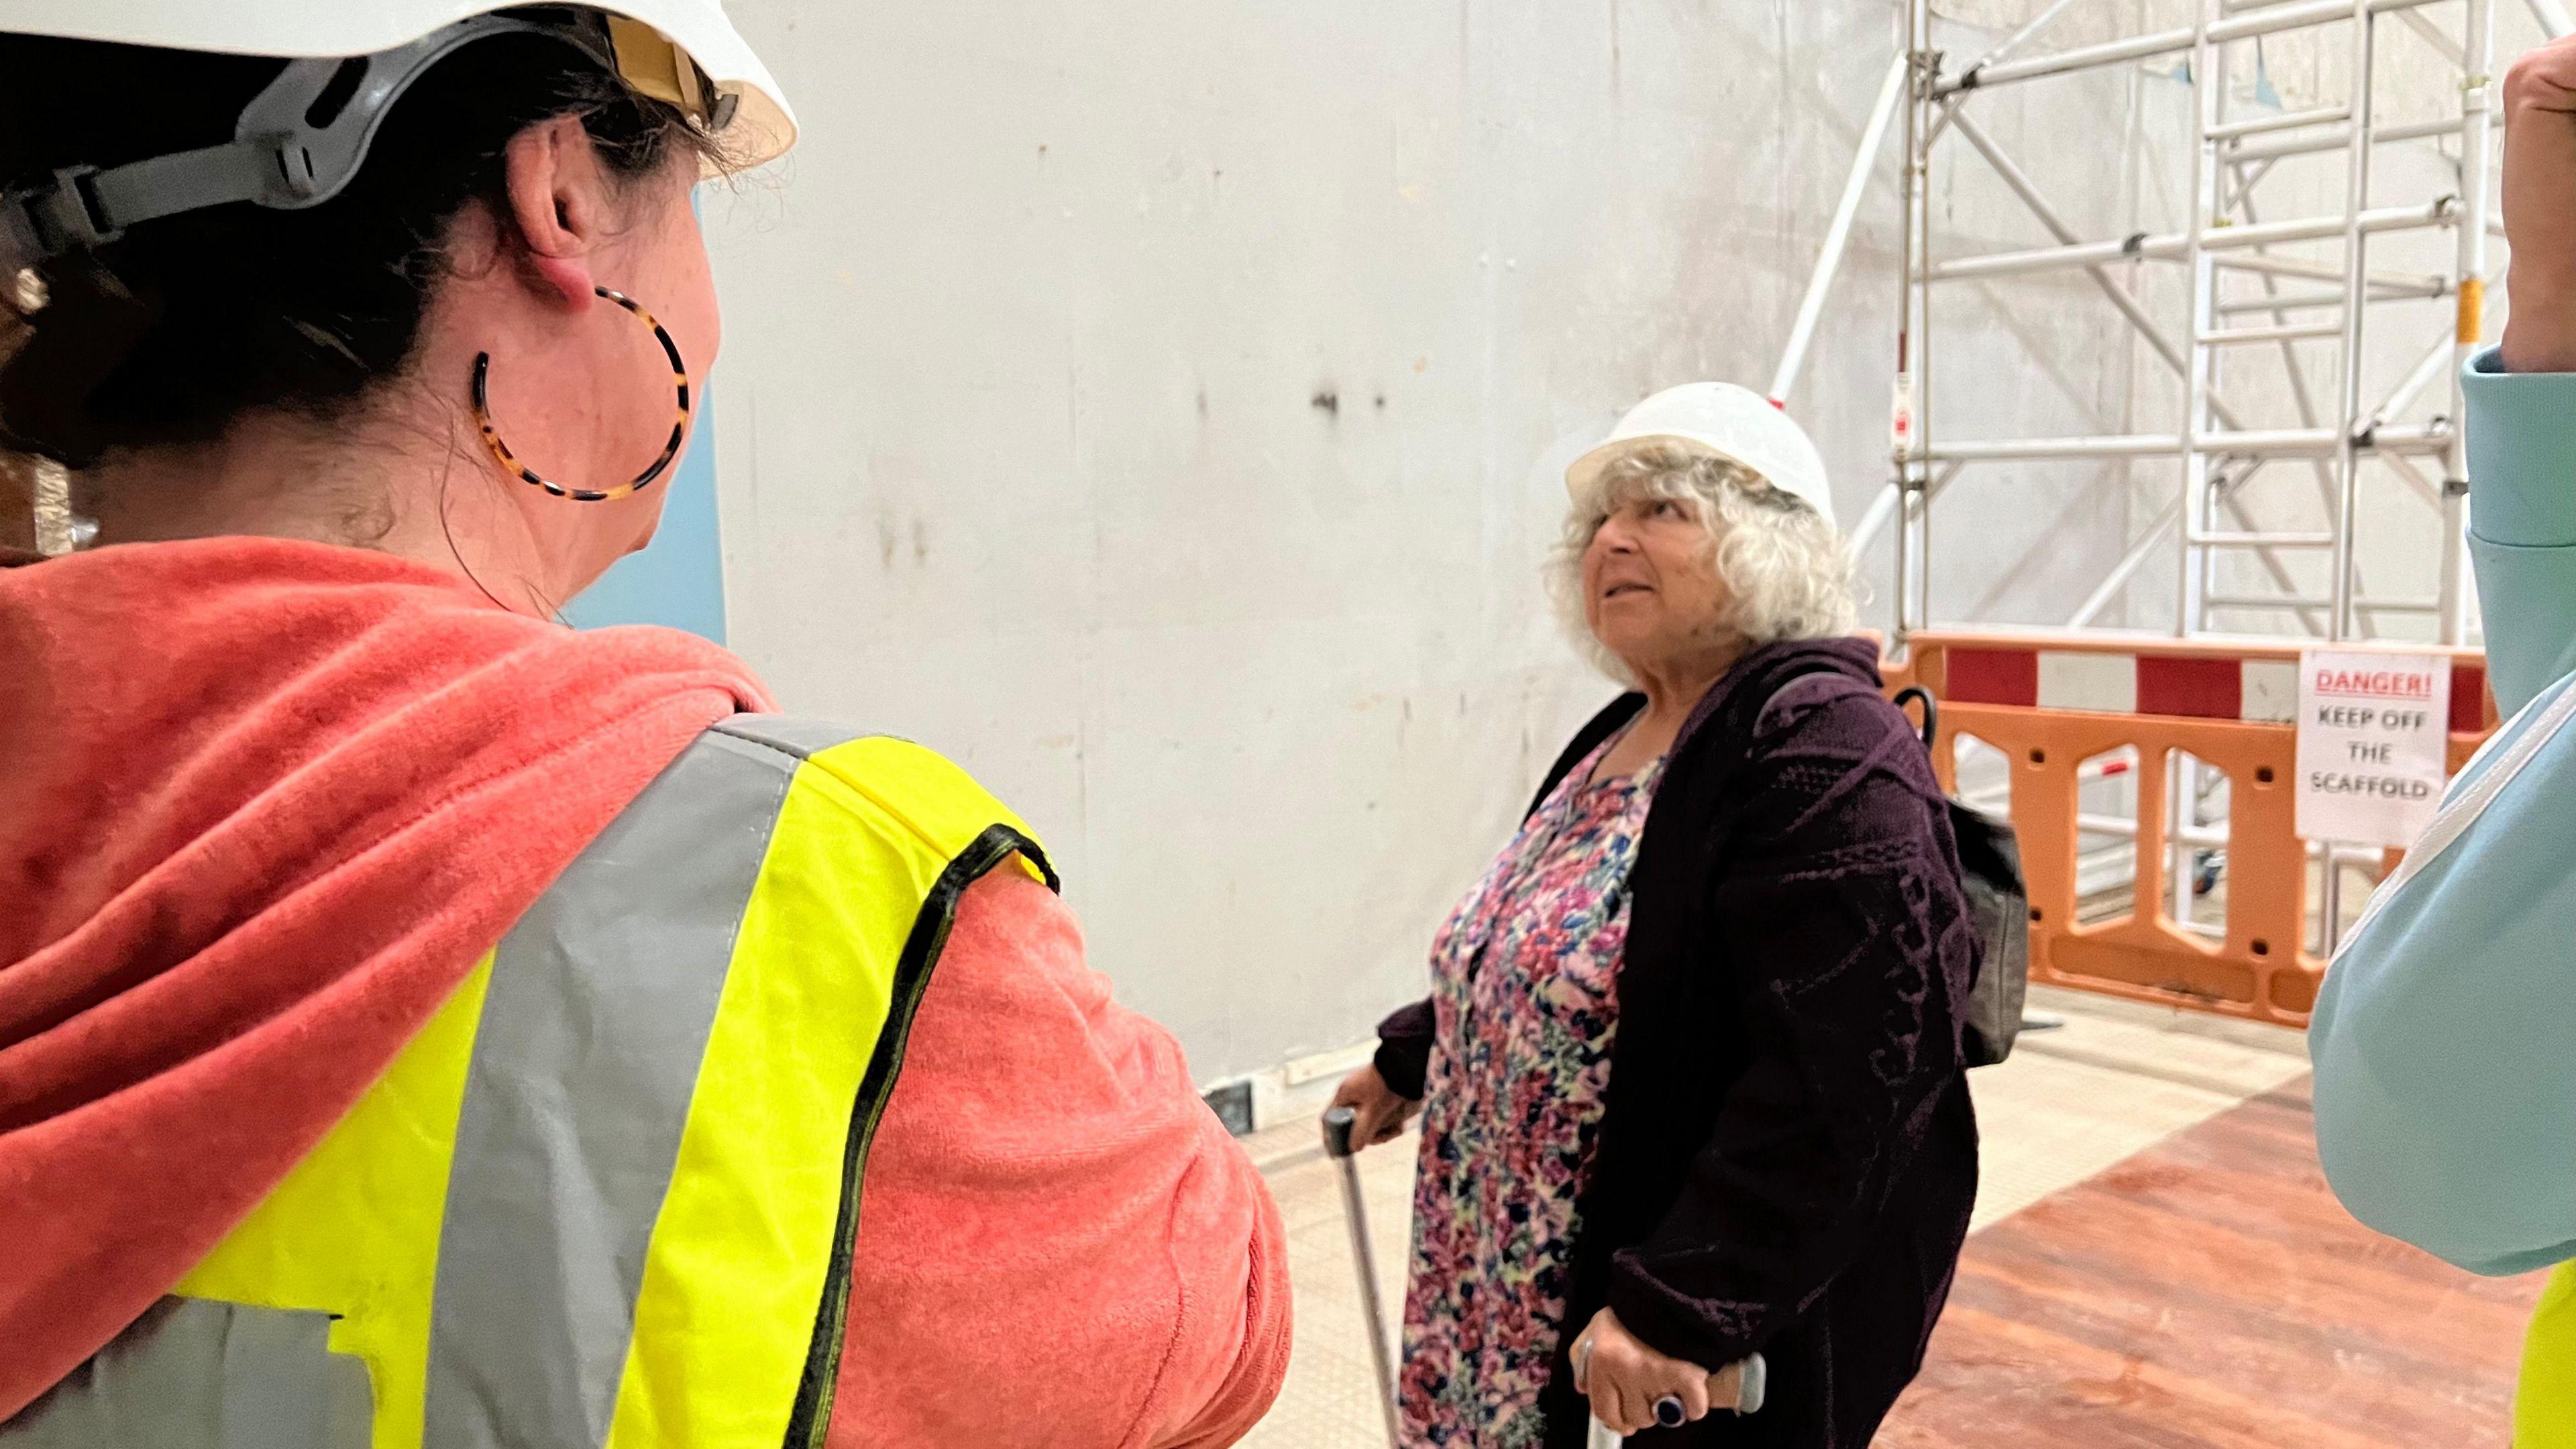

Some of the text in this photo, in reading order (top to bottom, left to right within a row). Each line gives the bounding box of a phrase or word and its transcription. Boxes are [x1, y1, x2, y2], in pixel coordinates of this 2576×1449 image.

[2316, 669, 2432, 696] DANGER!
[2318, 704, 2426, 730] KEEP OFF
[2347, 741, 2393, 764] THE
[2311, 771, 2428, 800] SCAFFOLD
